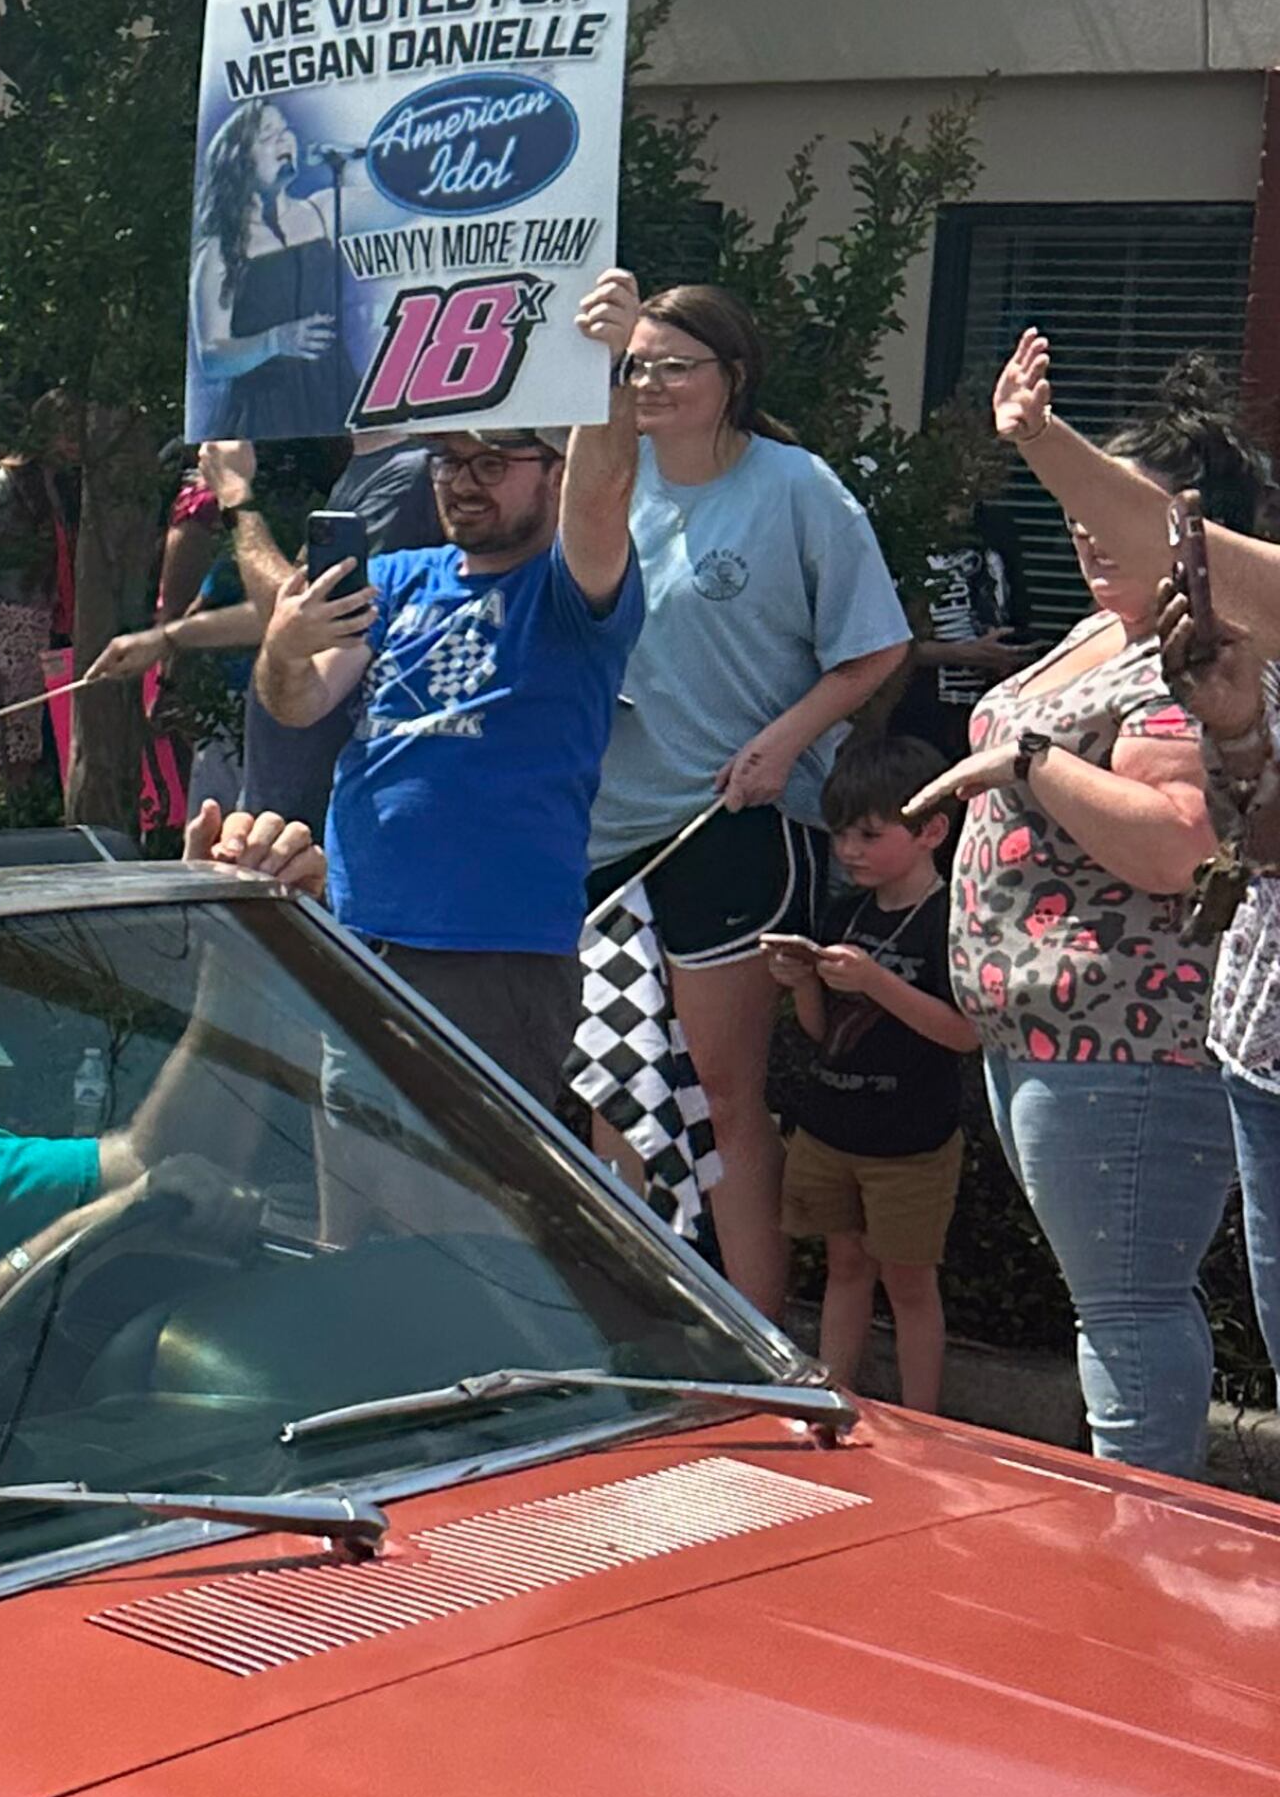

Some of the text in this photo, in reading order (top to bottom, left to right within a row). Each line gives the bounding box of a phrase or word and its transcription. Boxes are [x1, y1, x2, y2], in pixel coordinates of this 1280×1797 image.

[225, 12, 608, 99] MEGAN DANIELLE
[371, 88, 552, 153] American
[419, 137, 518, 198] Idol
[342, 217, 598, 277] WAYYY MORE THAN
